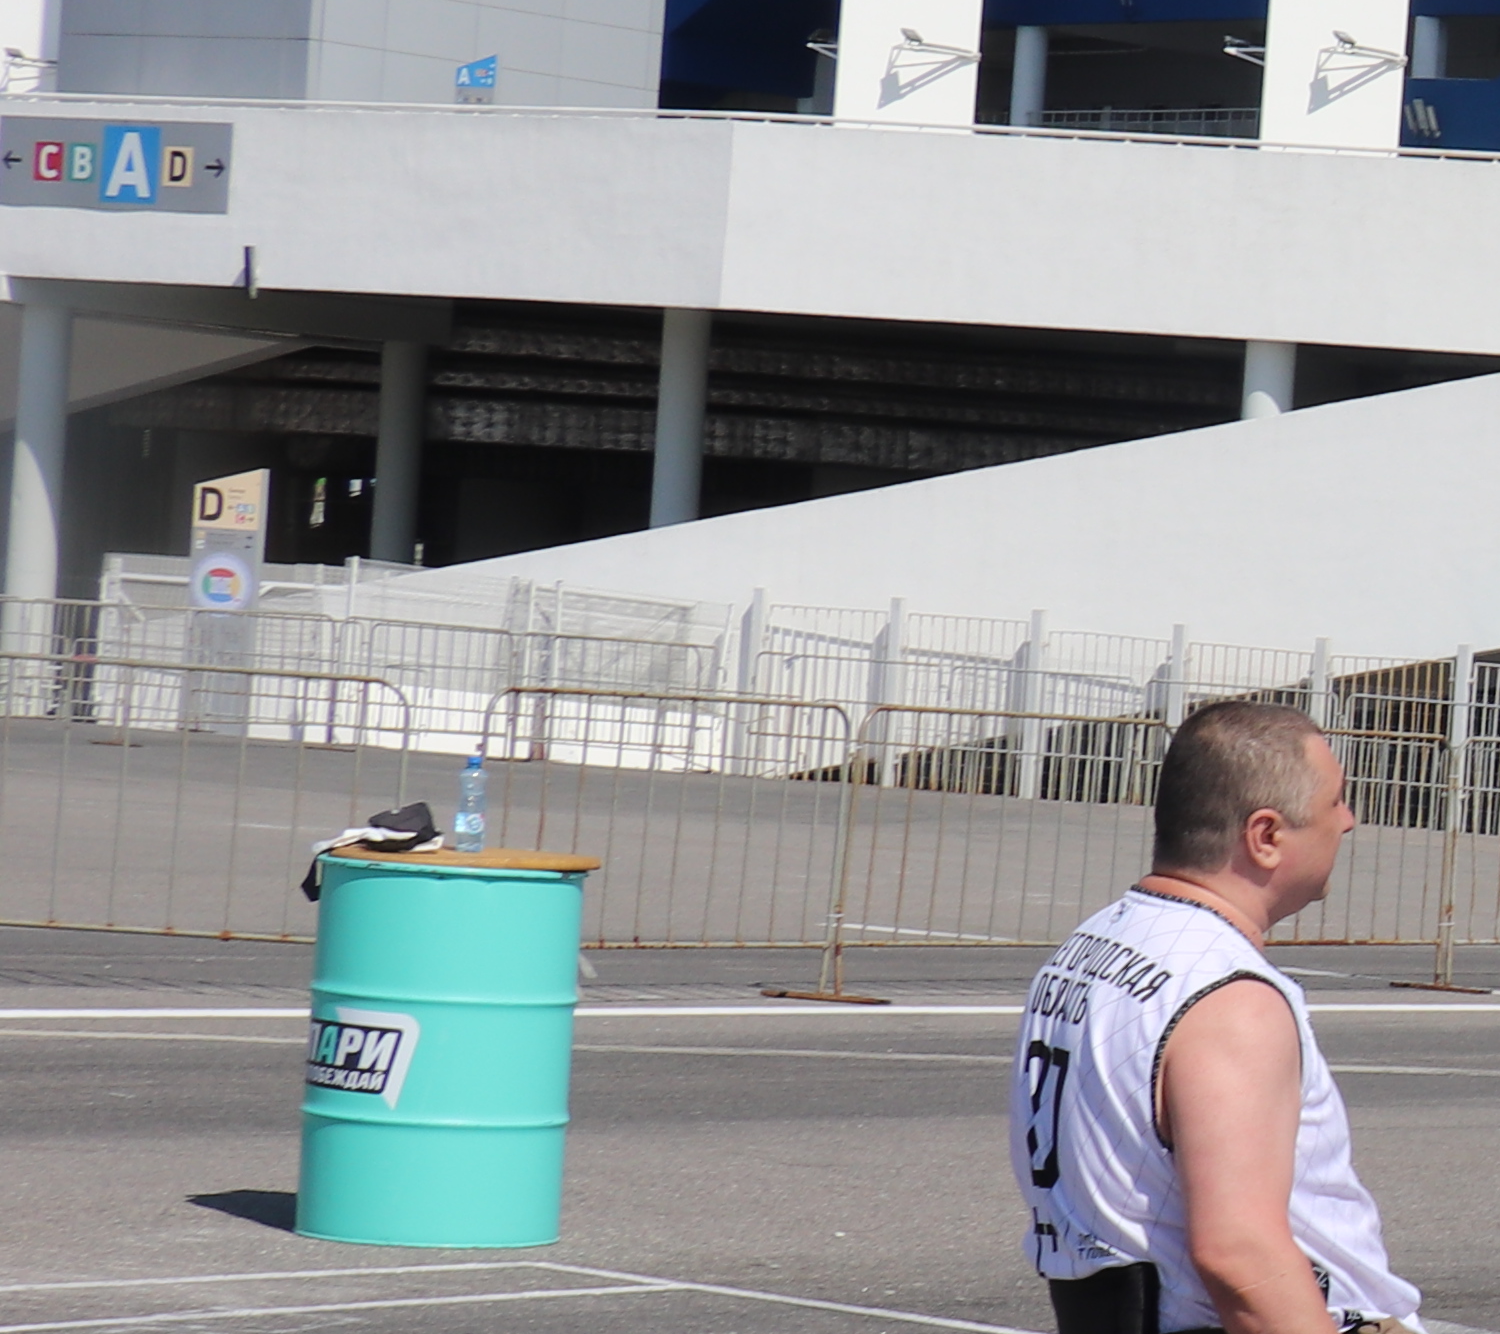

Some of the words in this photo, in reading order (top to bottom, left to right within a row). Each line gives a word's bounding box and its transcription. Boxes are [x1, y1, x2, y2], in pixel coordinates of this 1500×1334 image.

[38, 144, 59, 179] C
[71, 146, 93, 180] B
[105, 132, 151, 198] A
[169, 150, 187, 183] D
[199, 486, 224, 521] D
